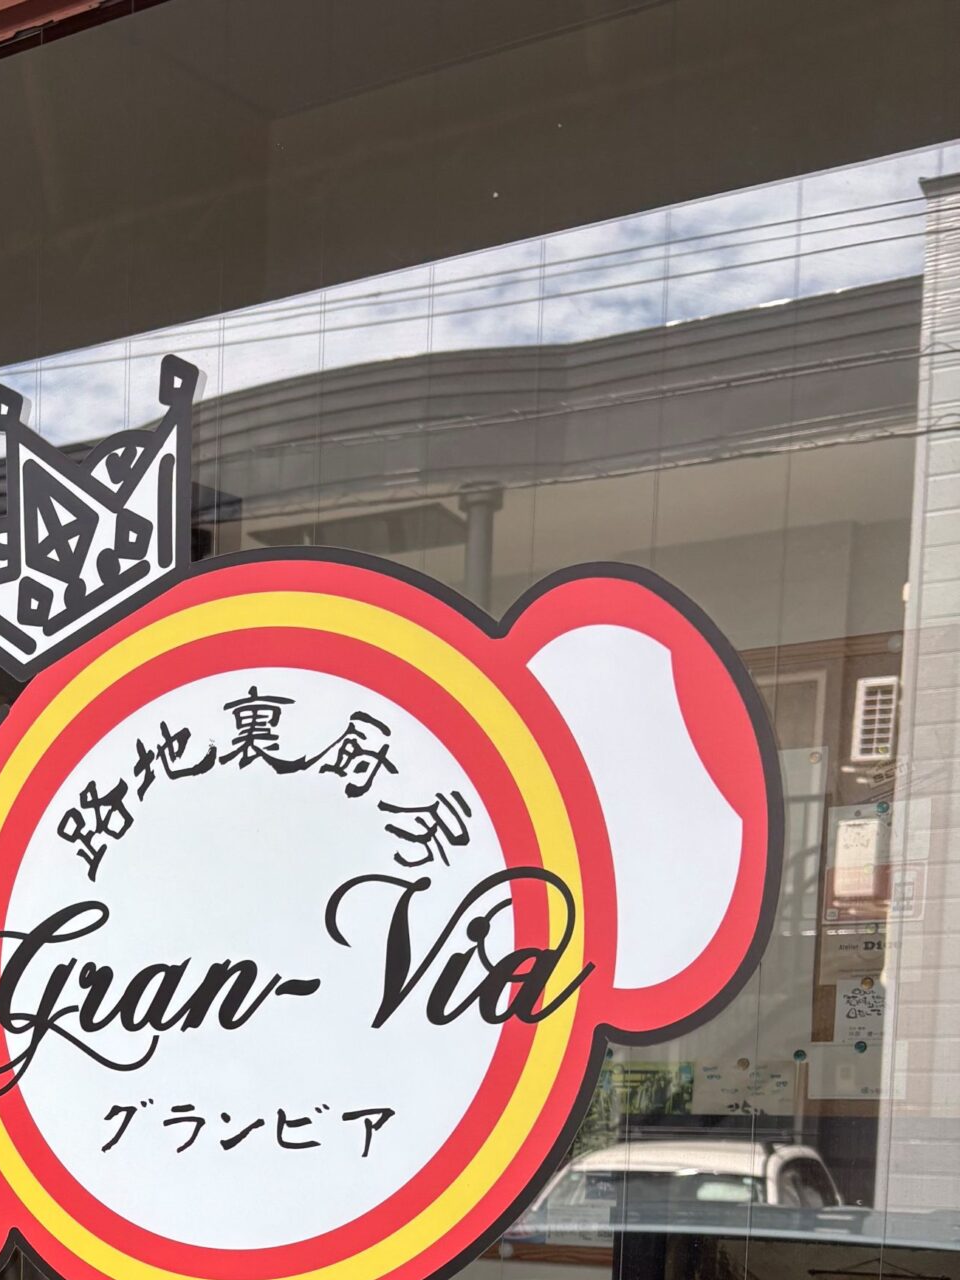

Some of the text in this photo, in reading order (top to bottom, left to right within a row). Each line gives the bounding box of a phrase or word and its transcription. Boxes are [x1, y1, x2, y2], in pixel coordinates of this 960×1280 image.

[56, 686, 474, 881] 路地裏厨房
[101, 1098, 396, 1157] グランビア
